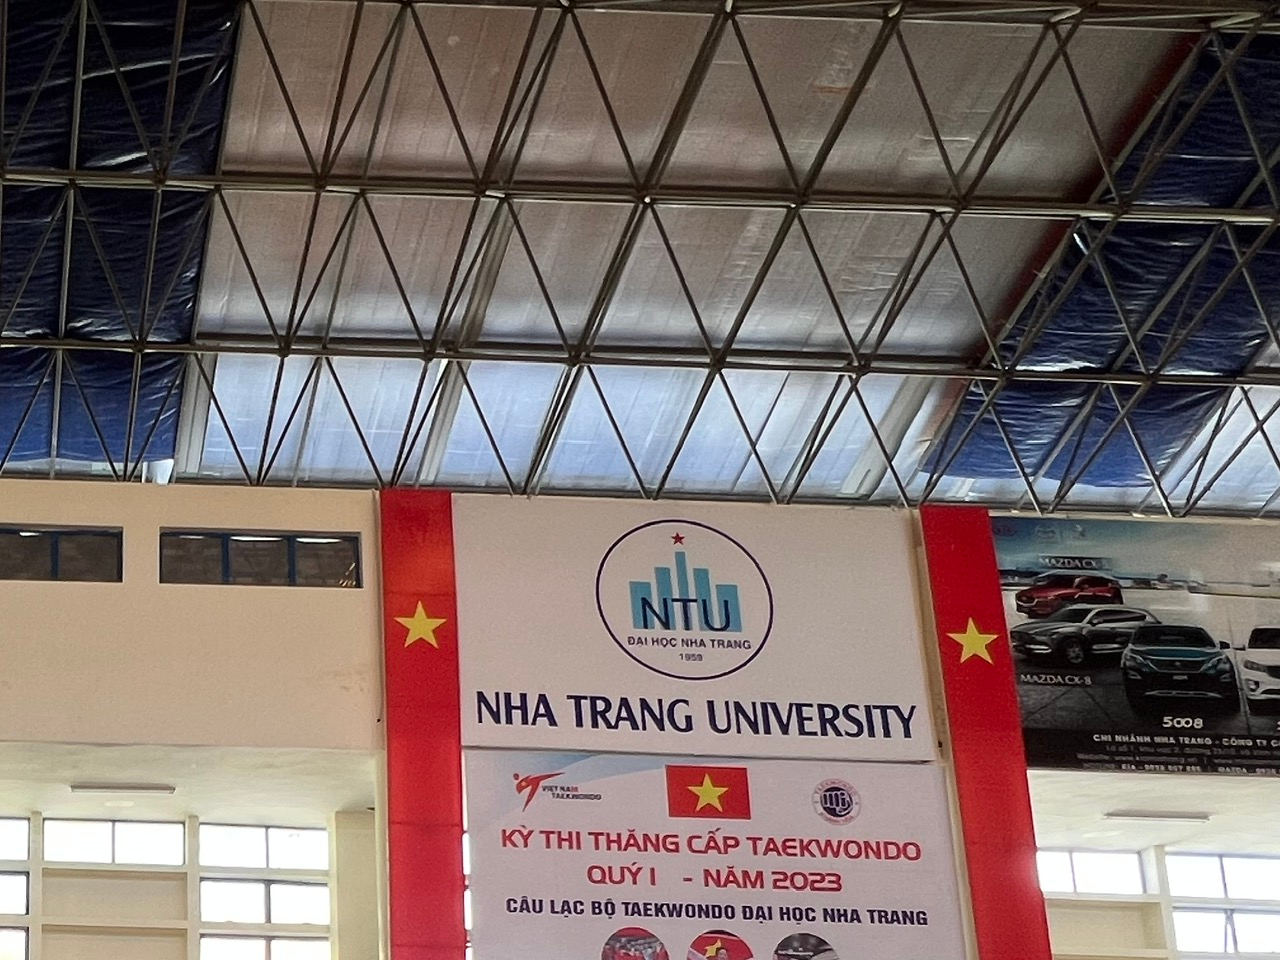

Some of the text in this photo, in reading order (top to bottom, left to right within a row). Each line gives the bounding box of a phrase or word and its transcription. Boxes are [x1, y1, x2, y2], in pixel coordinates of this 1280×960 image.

[640, 596, 731, 632] NTU
[681, 637, 707, 649] NHA
[709, 638, 752, 650] TRANG
[476, 690, 917, 740] NHA TRANG UNIVERSITY
[1161, 716, 1205, 729] 5008
[501, 825, 922, 862] KỲ THI THĂNG CẤP TAEKWONDO
[586, 862, 644, 887] QUÝ
[649, 867, 657, 886] I
[703, 865, 766, 890] NĂM
[772, 872, 843, 893] 2023
[505, 896, 928, 926] CÂU LẠC BỘ TAEKWONDO ĐẠI HỌC NHA TRANG
